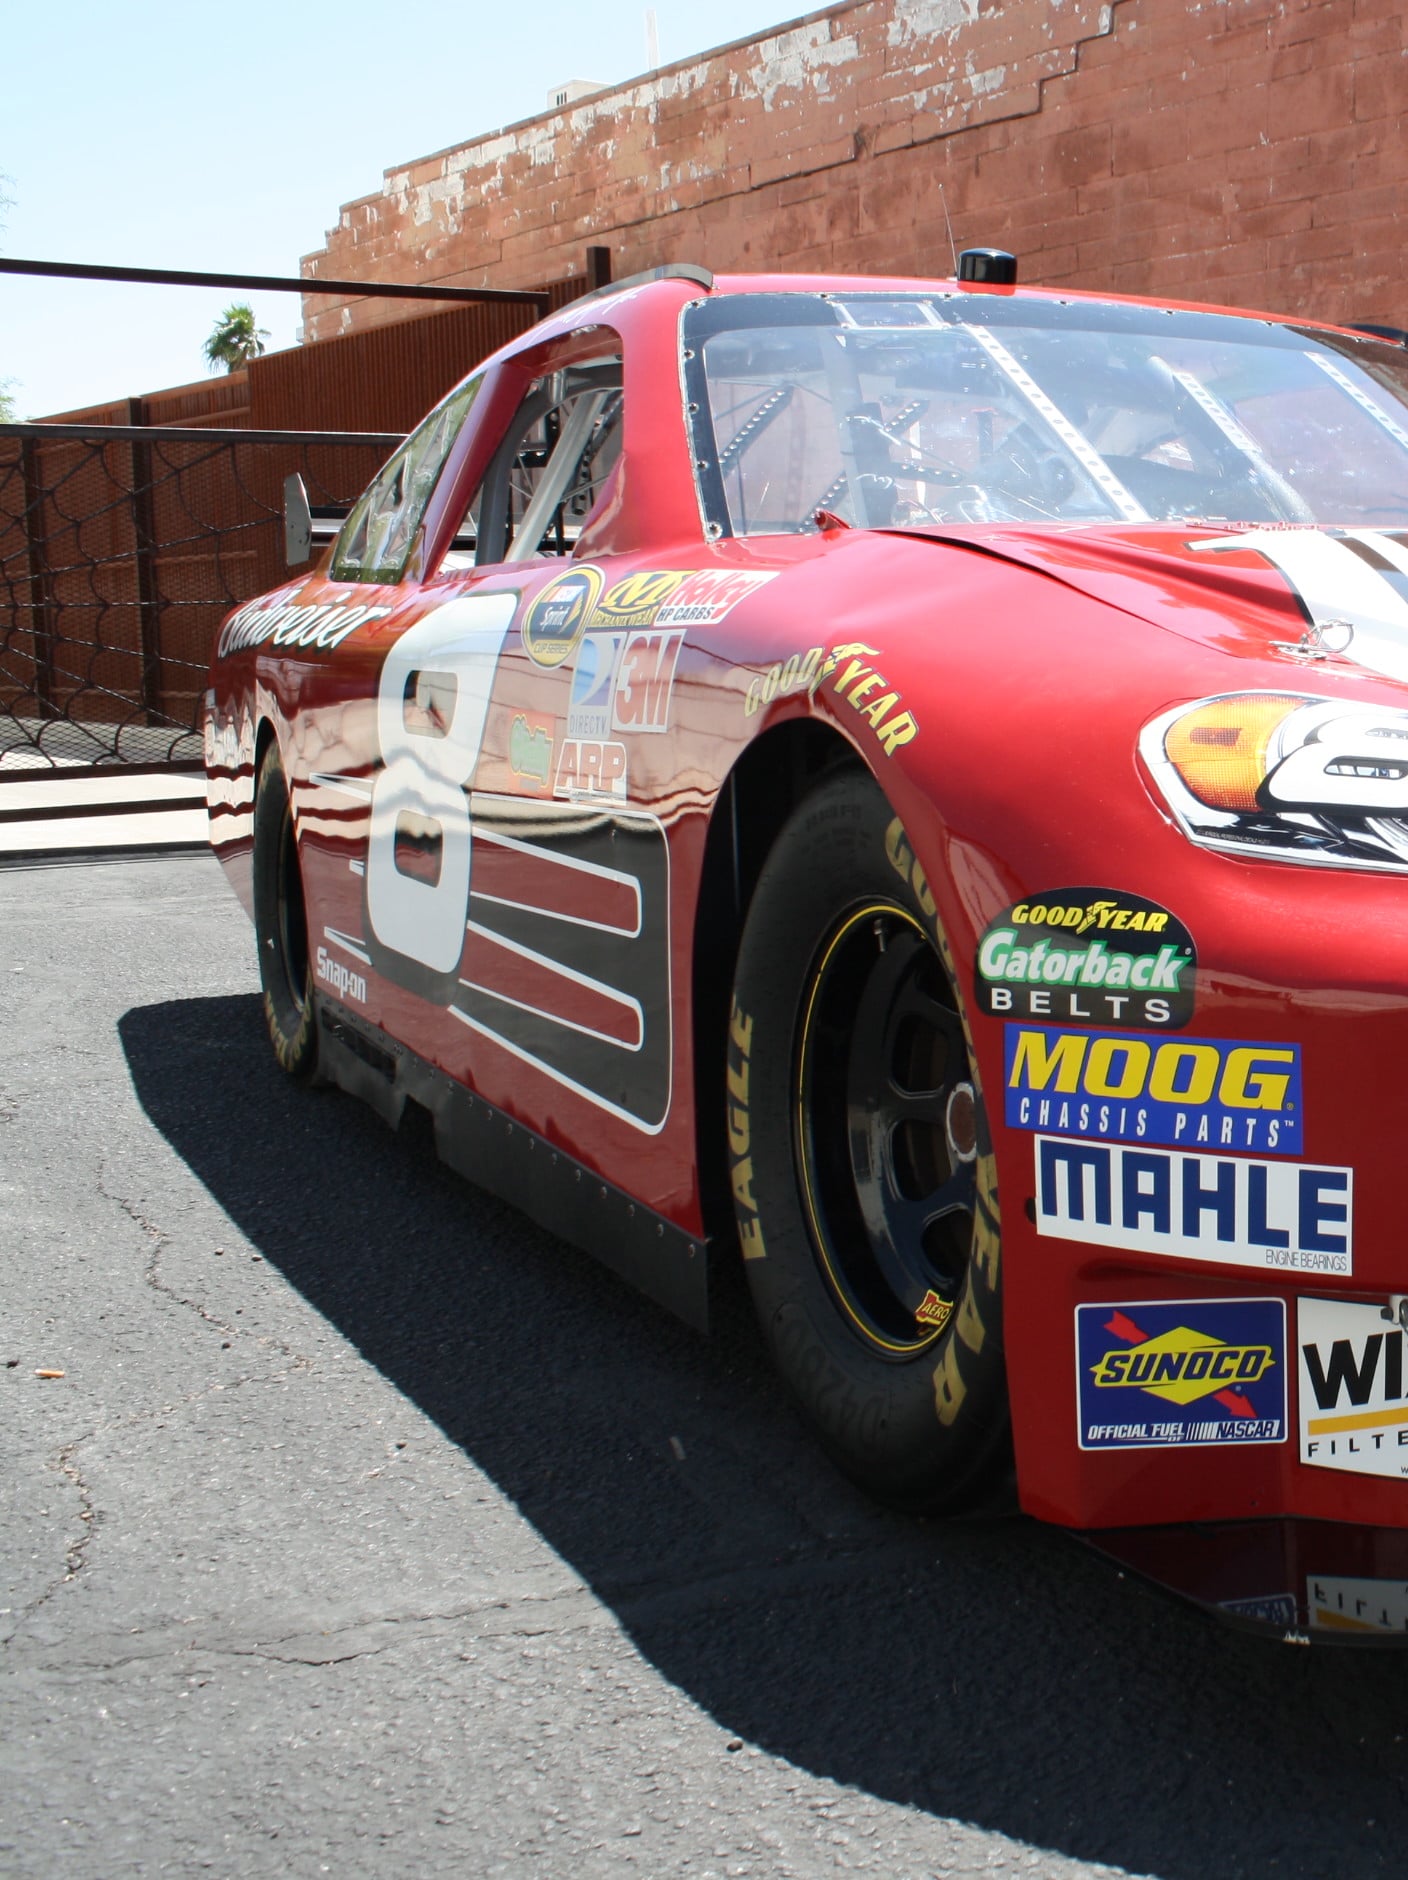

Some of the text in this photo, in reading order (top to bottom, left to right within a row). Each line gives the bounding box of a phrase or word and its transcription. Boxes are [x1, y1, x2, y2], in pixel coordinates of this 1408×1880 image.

[657, 605, 715, 622] HP CARBS
[615, 634, 683, 727] 3M
[366, 589, 520, 974] 8
[555, 740, 627, 793] ARP
[1011, 901, 1169, 935] GOODYEAR
[316, 945, 368, 1004] Snap-on
[979, 928, 1191, 992] Gatorback
[991, 987, 1171, 1023] BELTS
[1008, 1030, 1295, 1111] MOOG
[727, 992, 767, 1260] EAGLE
[1019, 1096, 1281, 1148] CHASSIS PARTS
[1039, 1139, 1348, 1253] MAHLE
[1265, 1248, 1348, 1272] ENGINE BEARINGS
[921, 1302, 950, 1319] AERO
[1099, 1348, 1267, 1384] SUNOCO
[1087, 1422, 1185, 1440] OFFICIAL FUEL
[1217, 1420, 1277, 1438] NASCAR
